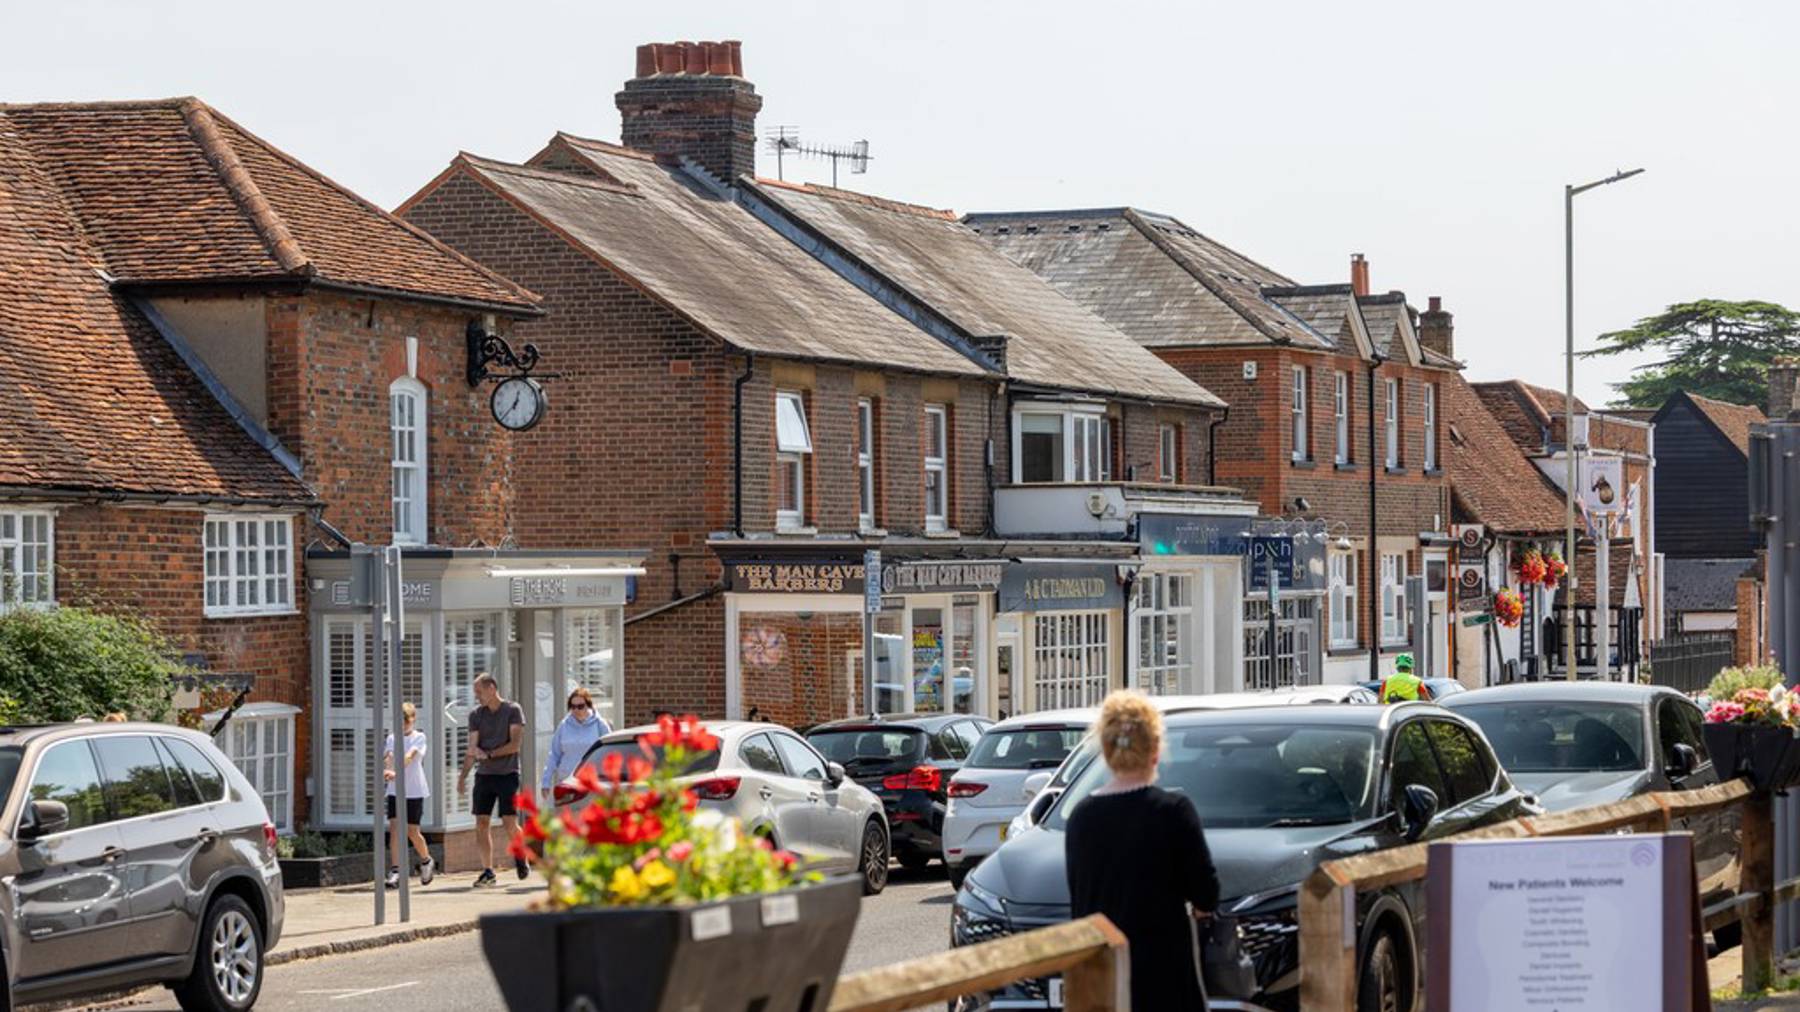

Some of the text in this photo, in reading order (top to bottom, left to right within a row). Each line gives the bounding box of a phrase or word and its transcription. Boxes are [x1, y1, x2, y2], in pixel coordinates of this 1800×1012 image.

[735, 564, 865, 578] THE MAN CAVE
[401, 583, 431, 595] OME
[748, 578, 844, 592] BARBERS
[1488, 877, 1624, 891] New Patients Welcome
